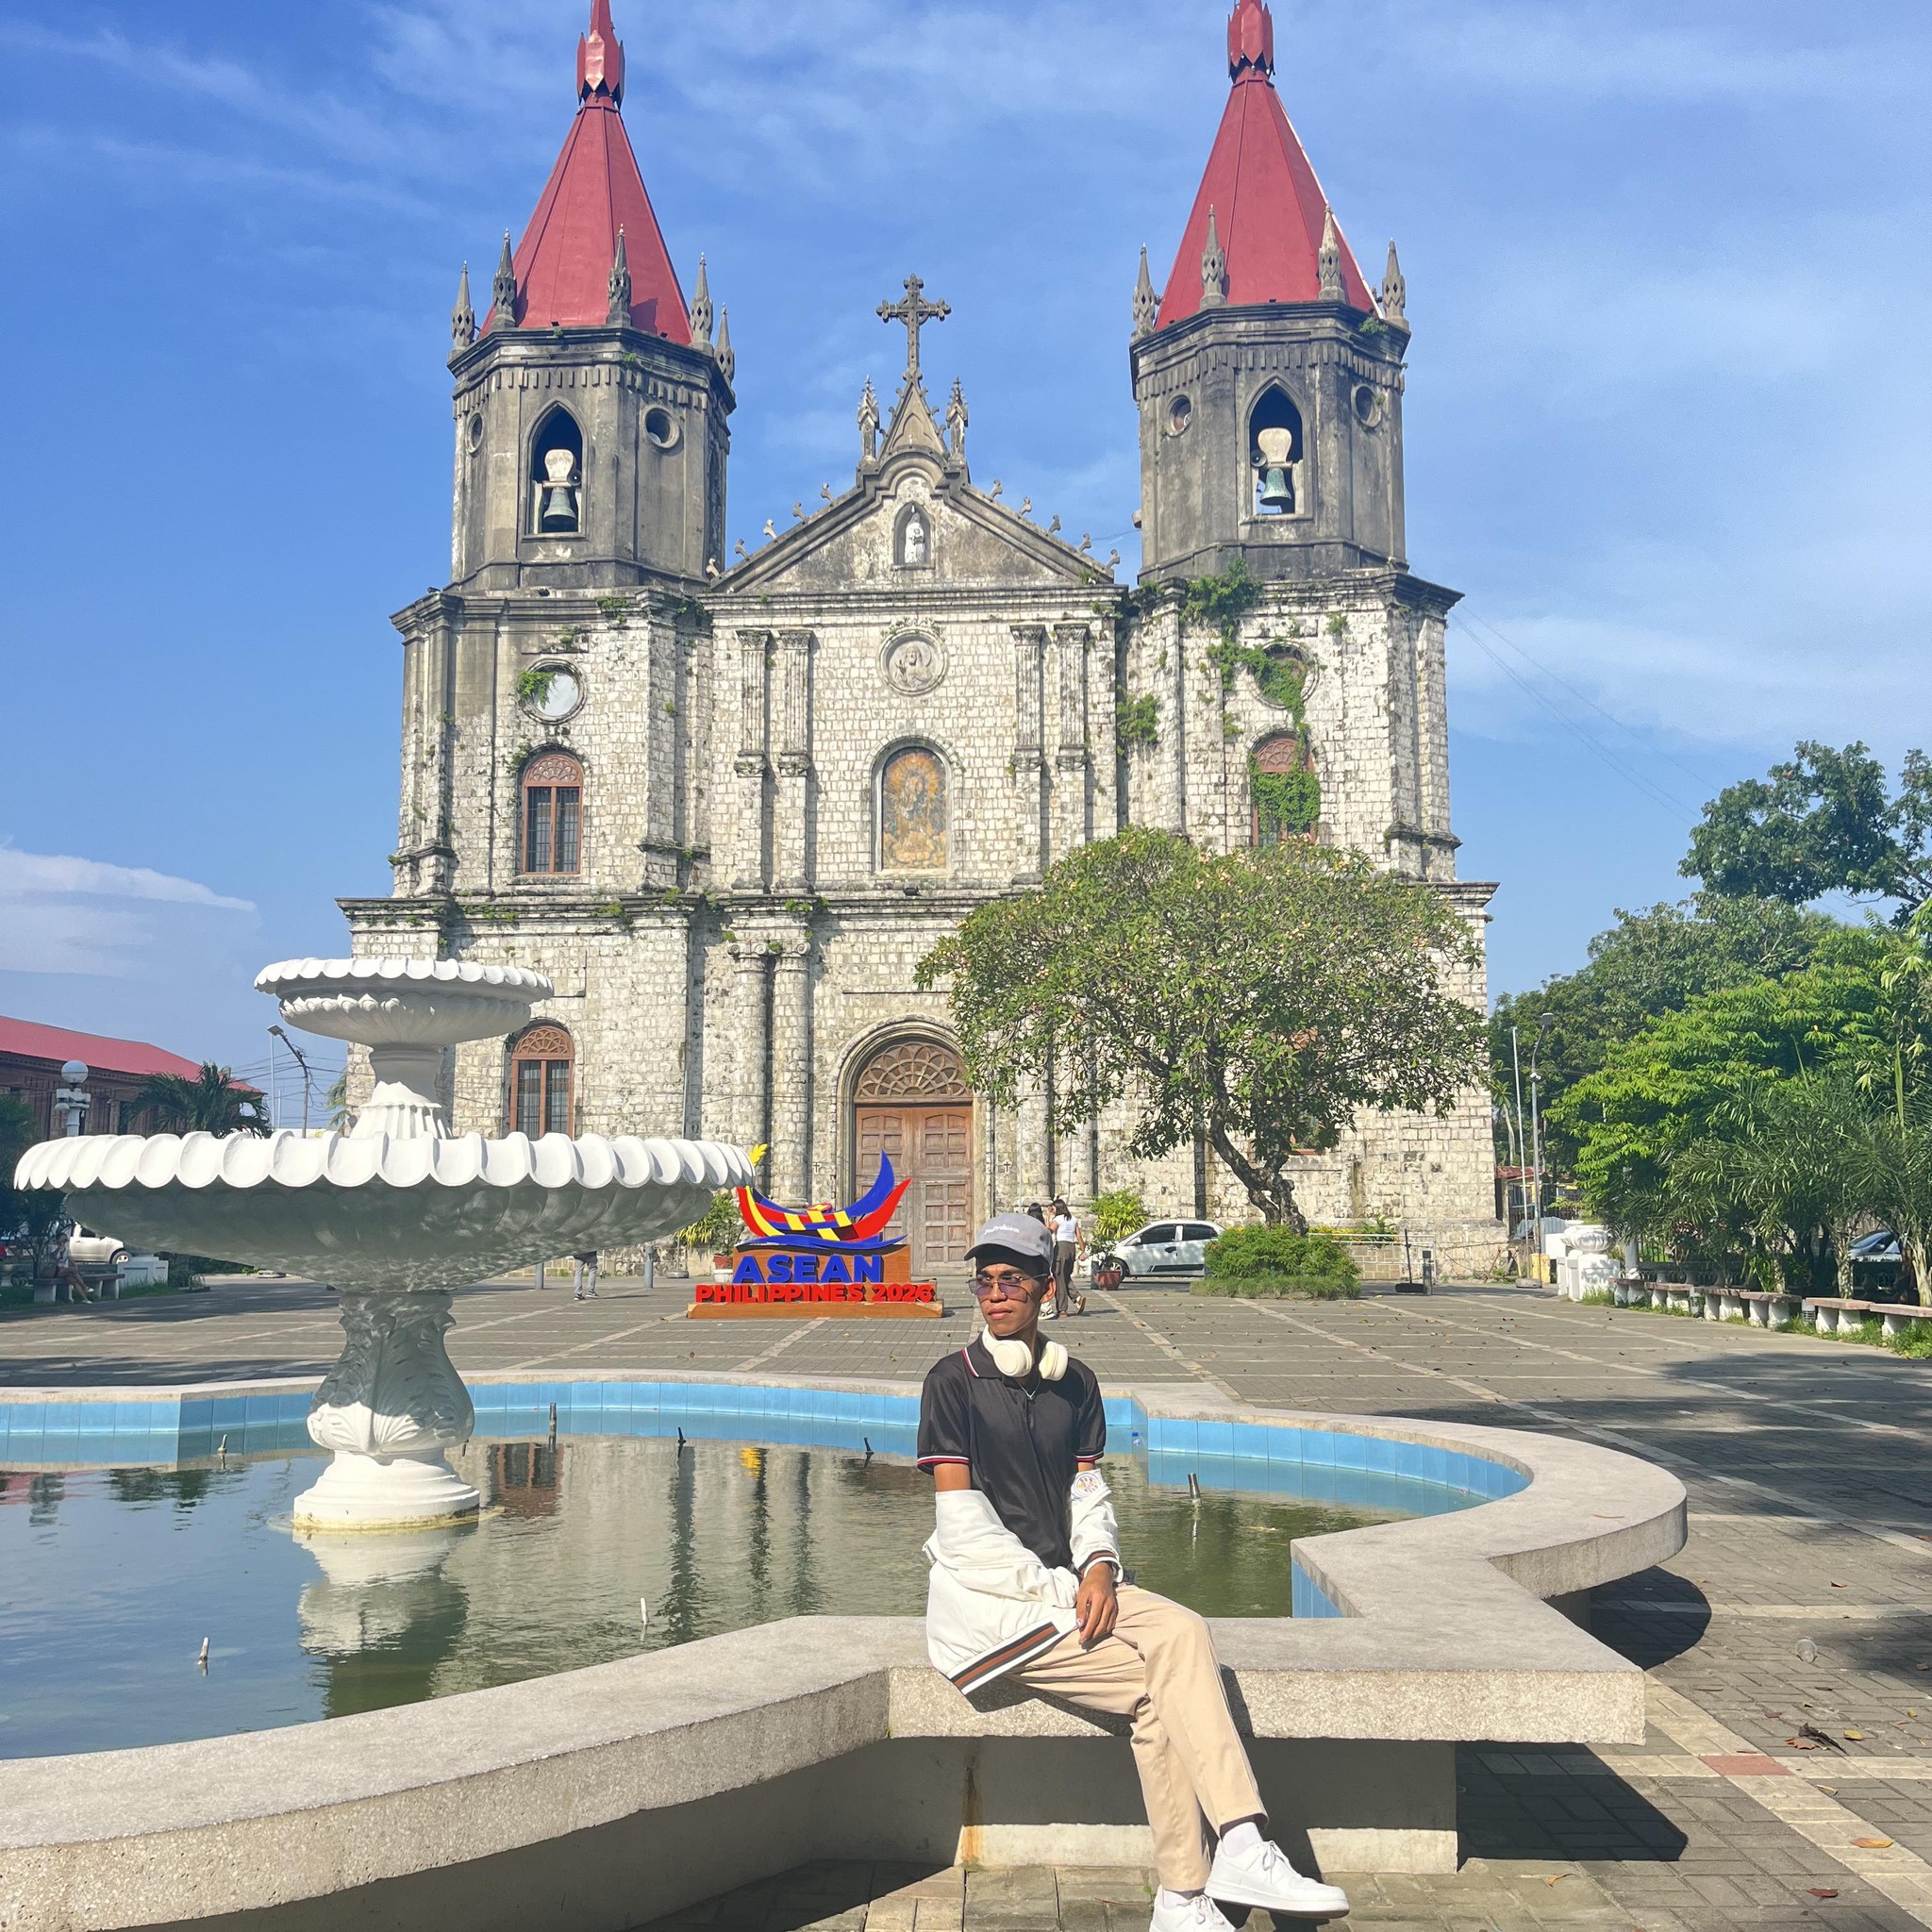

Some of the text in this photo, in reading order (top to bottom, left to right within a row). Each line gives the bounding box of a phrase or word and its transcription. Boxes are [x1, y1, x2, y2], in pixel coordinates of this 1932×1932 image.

[732, 1254, 882, 1284] ASEAN
[695, 1283, 933, 1303] PHILIPPINES 2026
